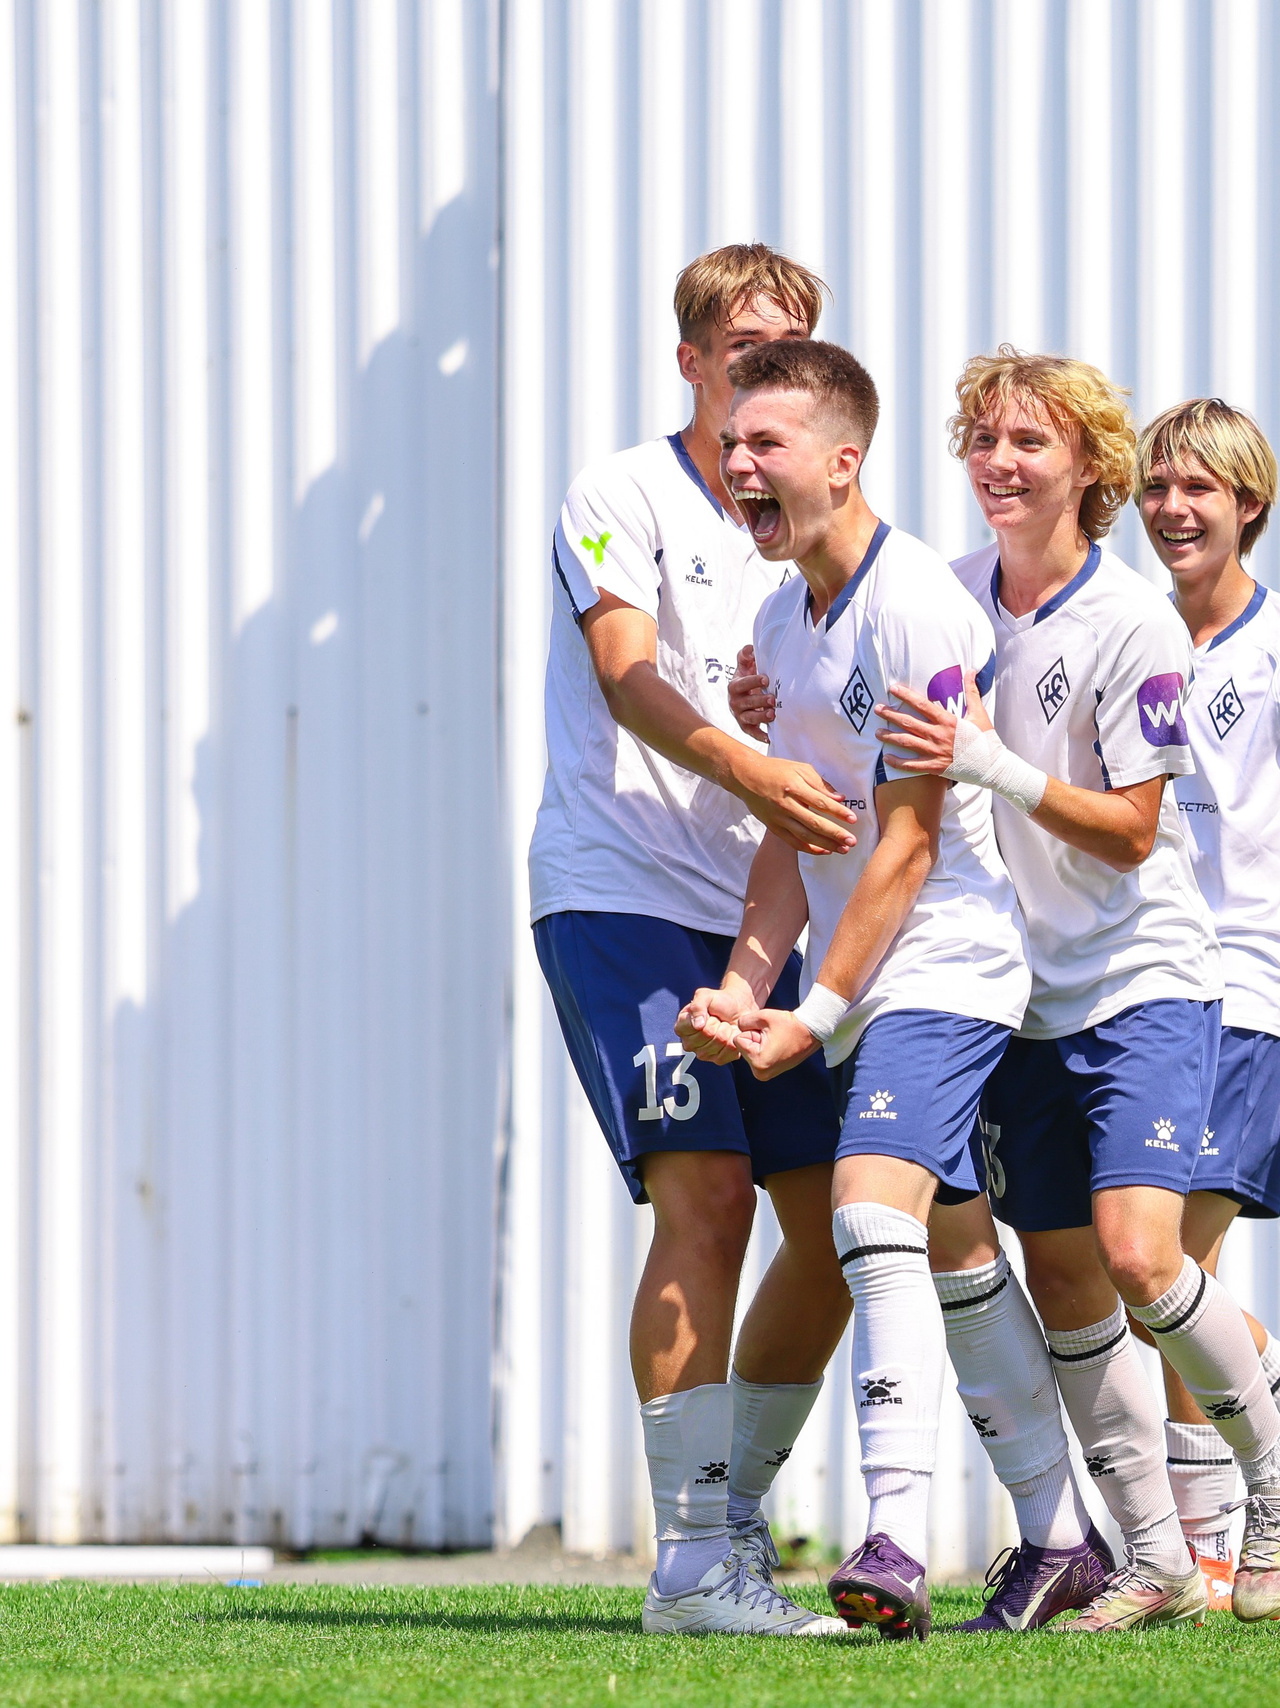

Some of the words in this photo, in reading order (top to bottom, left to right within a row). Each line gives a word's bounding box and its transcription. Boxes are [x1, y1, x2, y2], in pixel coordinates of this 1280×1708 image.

[685, 574, 713, 587] KELME
[633, 1042, 701, 1121] 13
[859, 1110, 898, 1120] KELME
[1145, 1138, 1180, 1152] KELME
[1199, 1147, 1220, 1156] LME
[860, 1397, 903, 1408] KELME
